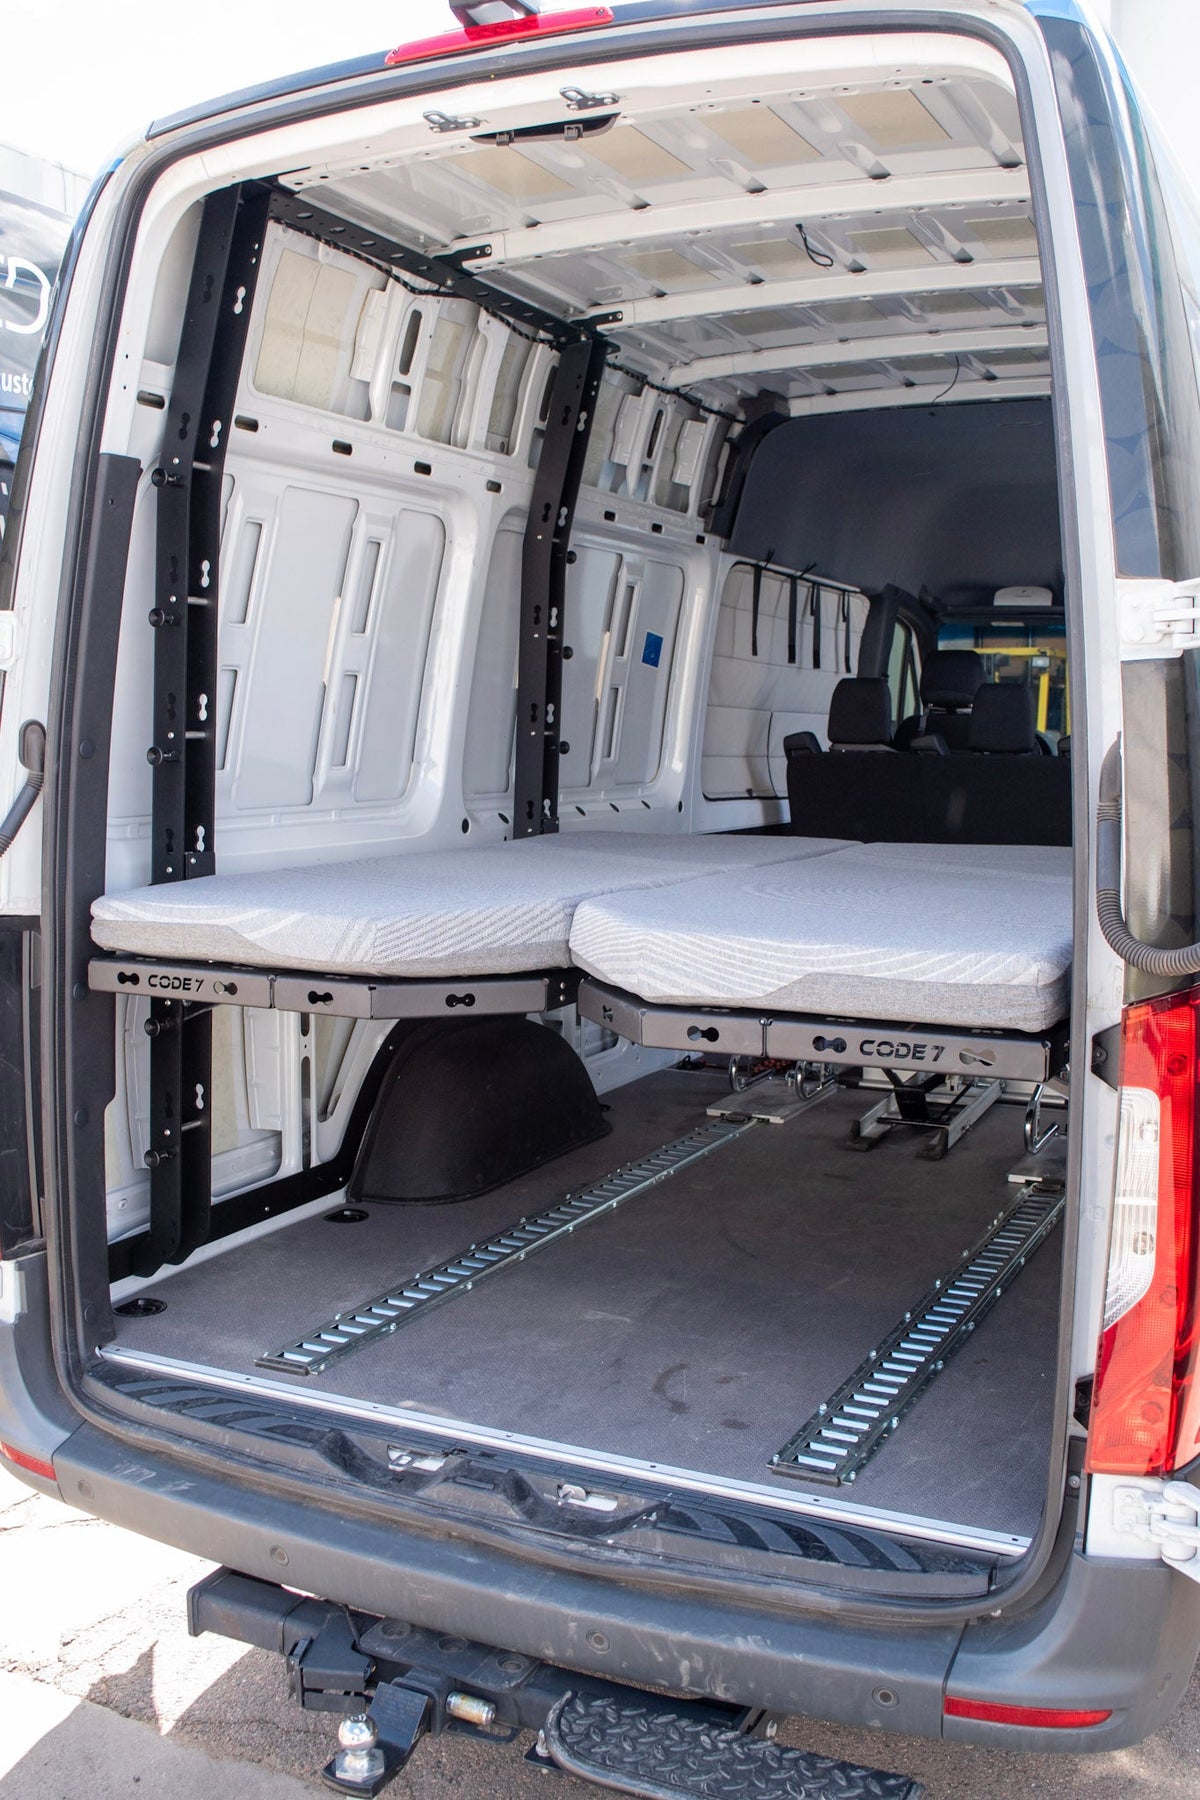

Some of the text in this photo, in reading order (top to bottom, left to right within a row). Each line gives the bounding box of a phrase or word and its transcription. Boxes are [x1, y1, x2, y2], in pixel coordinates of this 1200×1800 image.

[148, 974, 204, 993] CODE 7
[859, 1039, 945, 1062] CODE 7
